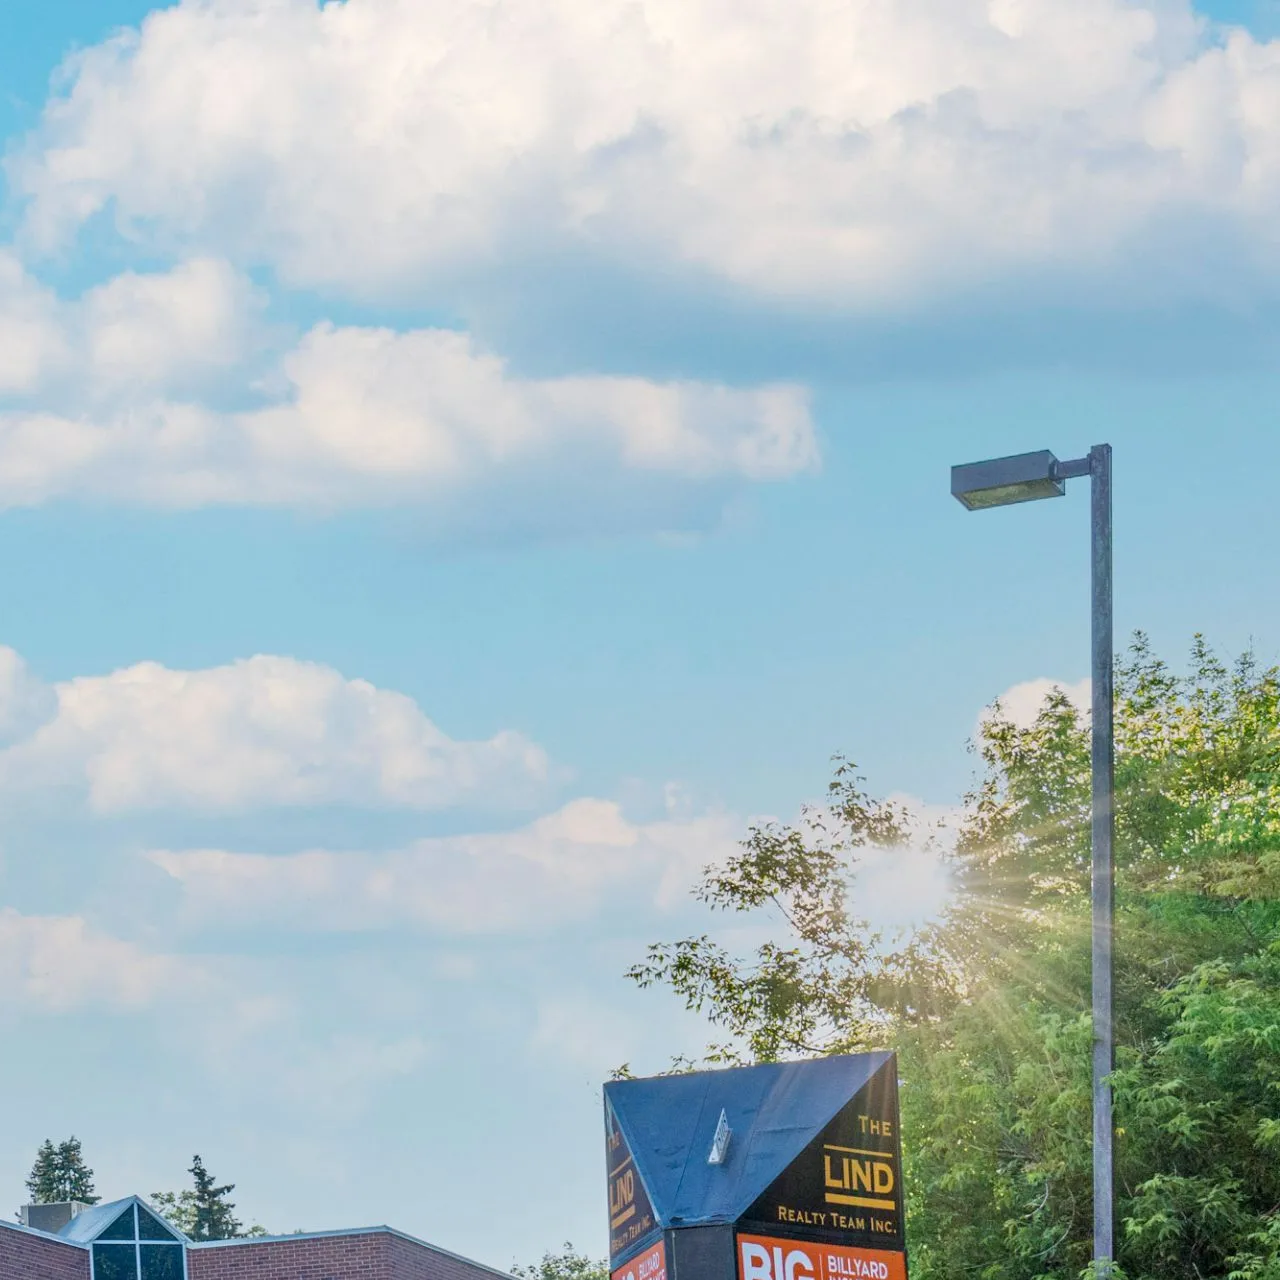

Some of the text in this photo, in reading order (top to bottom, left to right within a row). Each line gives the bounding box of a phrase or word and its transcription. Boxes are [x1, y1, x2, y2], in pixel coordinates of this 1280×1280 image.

[858, 1114, 892, 1136] THE
[824, 1154, 895, 1194] LIND
[610, 1169, 634, 1216] LIND
[778, 1206, 897, 1234] REALTY TEAM INC.
[639, 1251, 660, 1280] BILLYARD
[827, 1255, 889, 1280] BILLYARD
